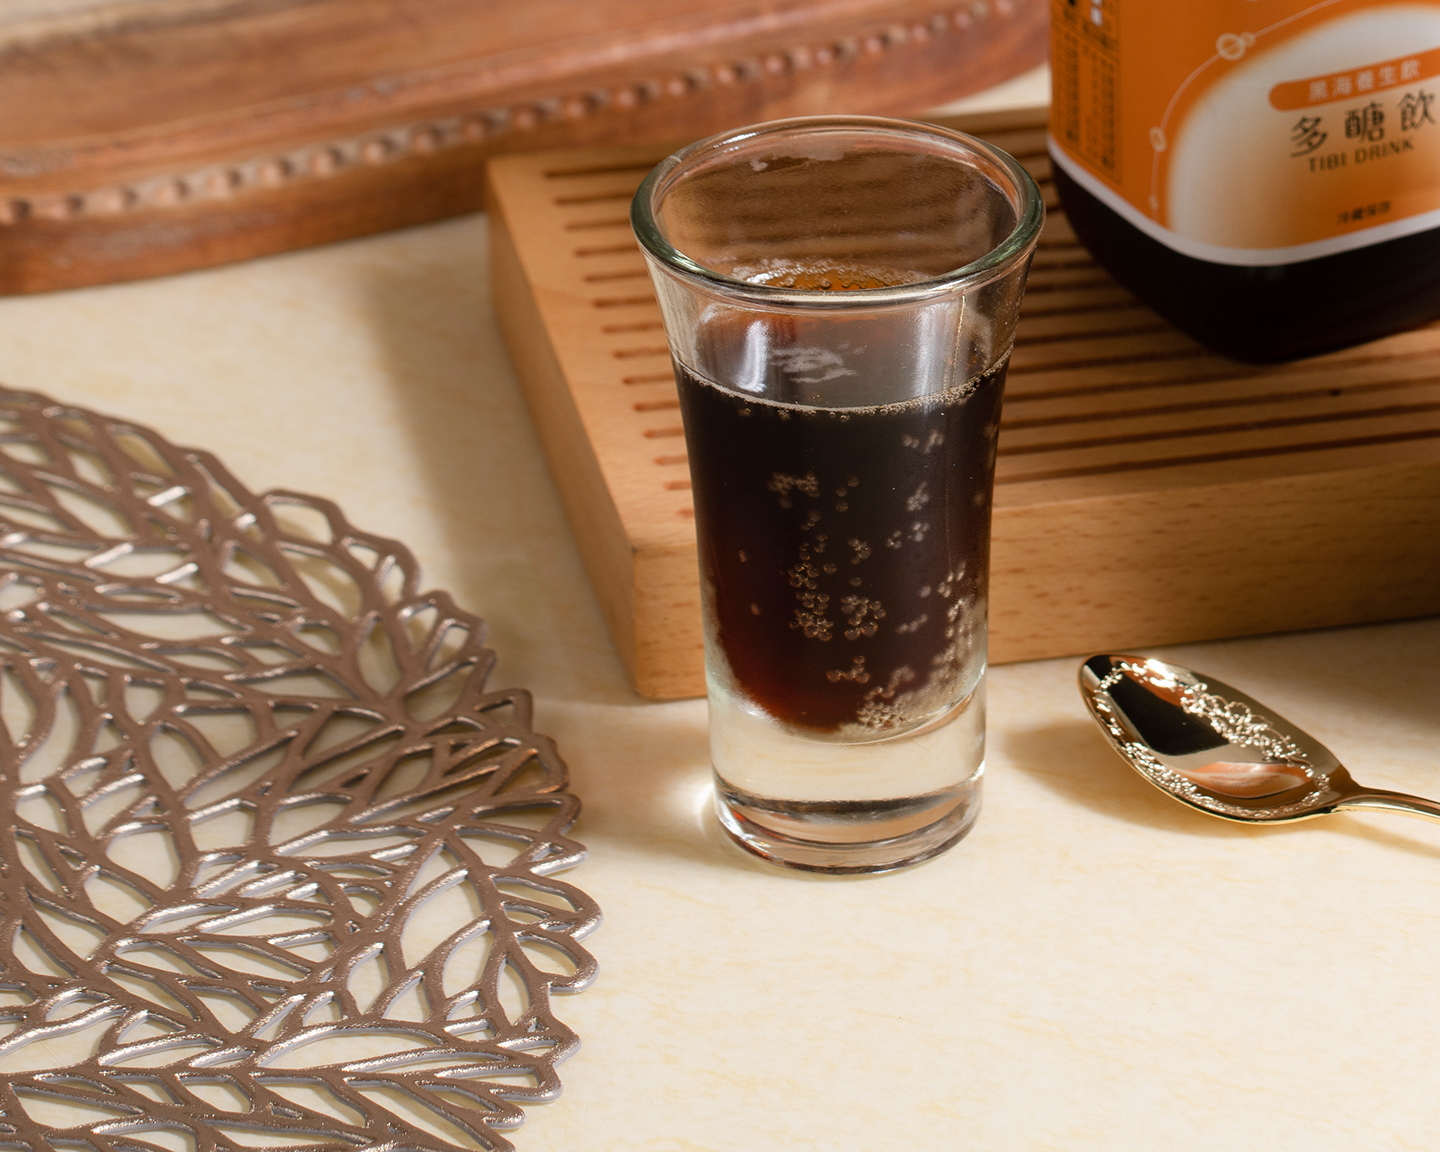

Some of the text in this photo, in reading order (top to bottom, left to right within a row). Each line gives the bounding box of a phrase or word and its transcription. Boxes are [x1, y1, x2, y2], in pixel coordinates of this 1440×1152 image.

[1290, 89, 1436, 159] 多醣飲
[1307, 137, 1414, 173] TIBI DRINK
